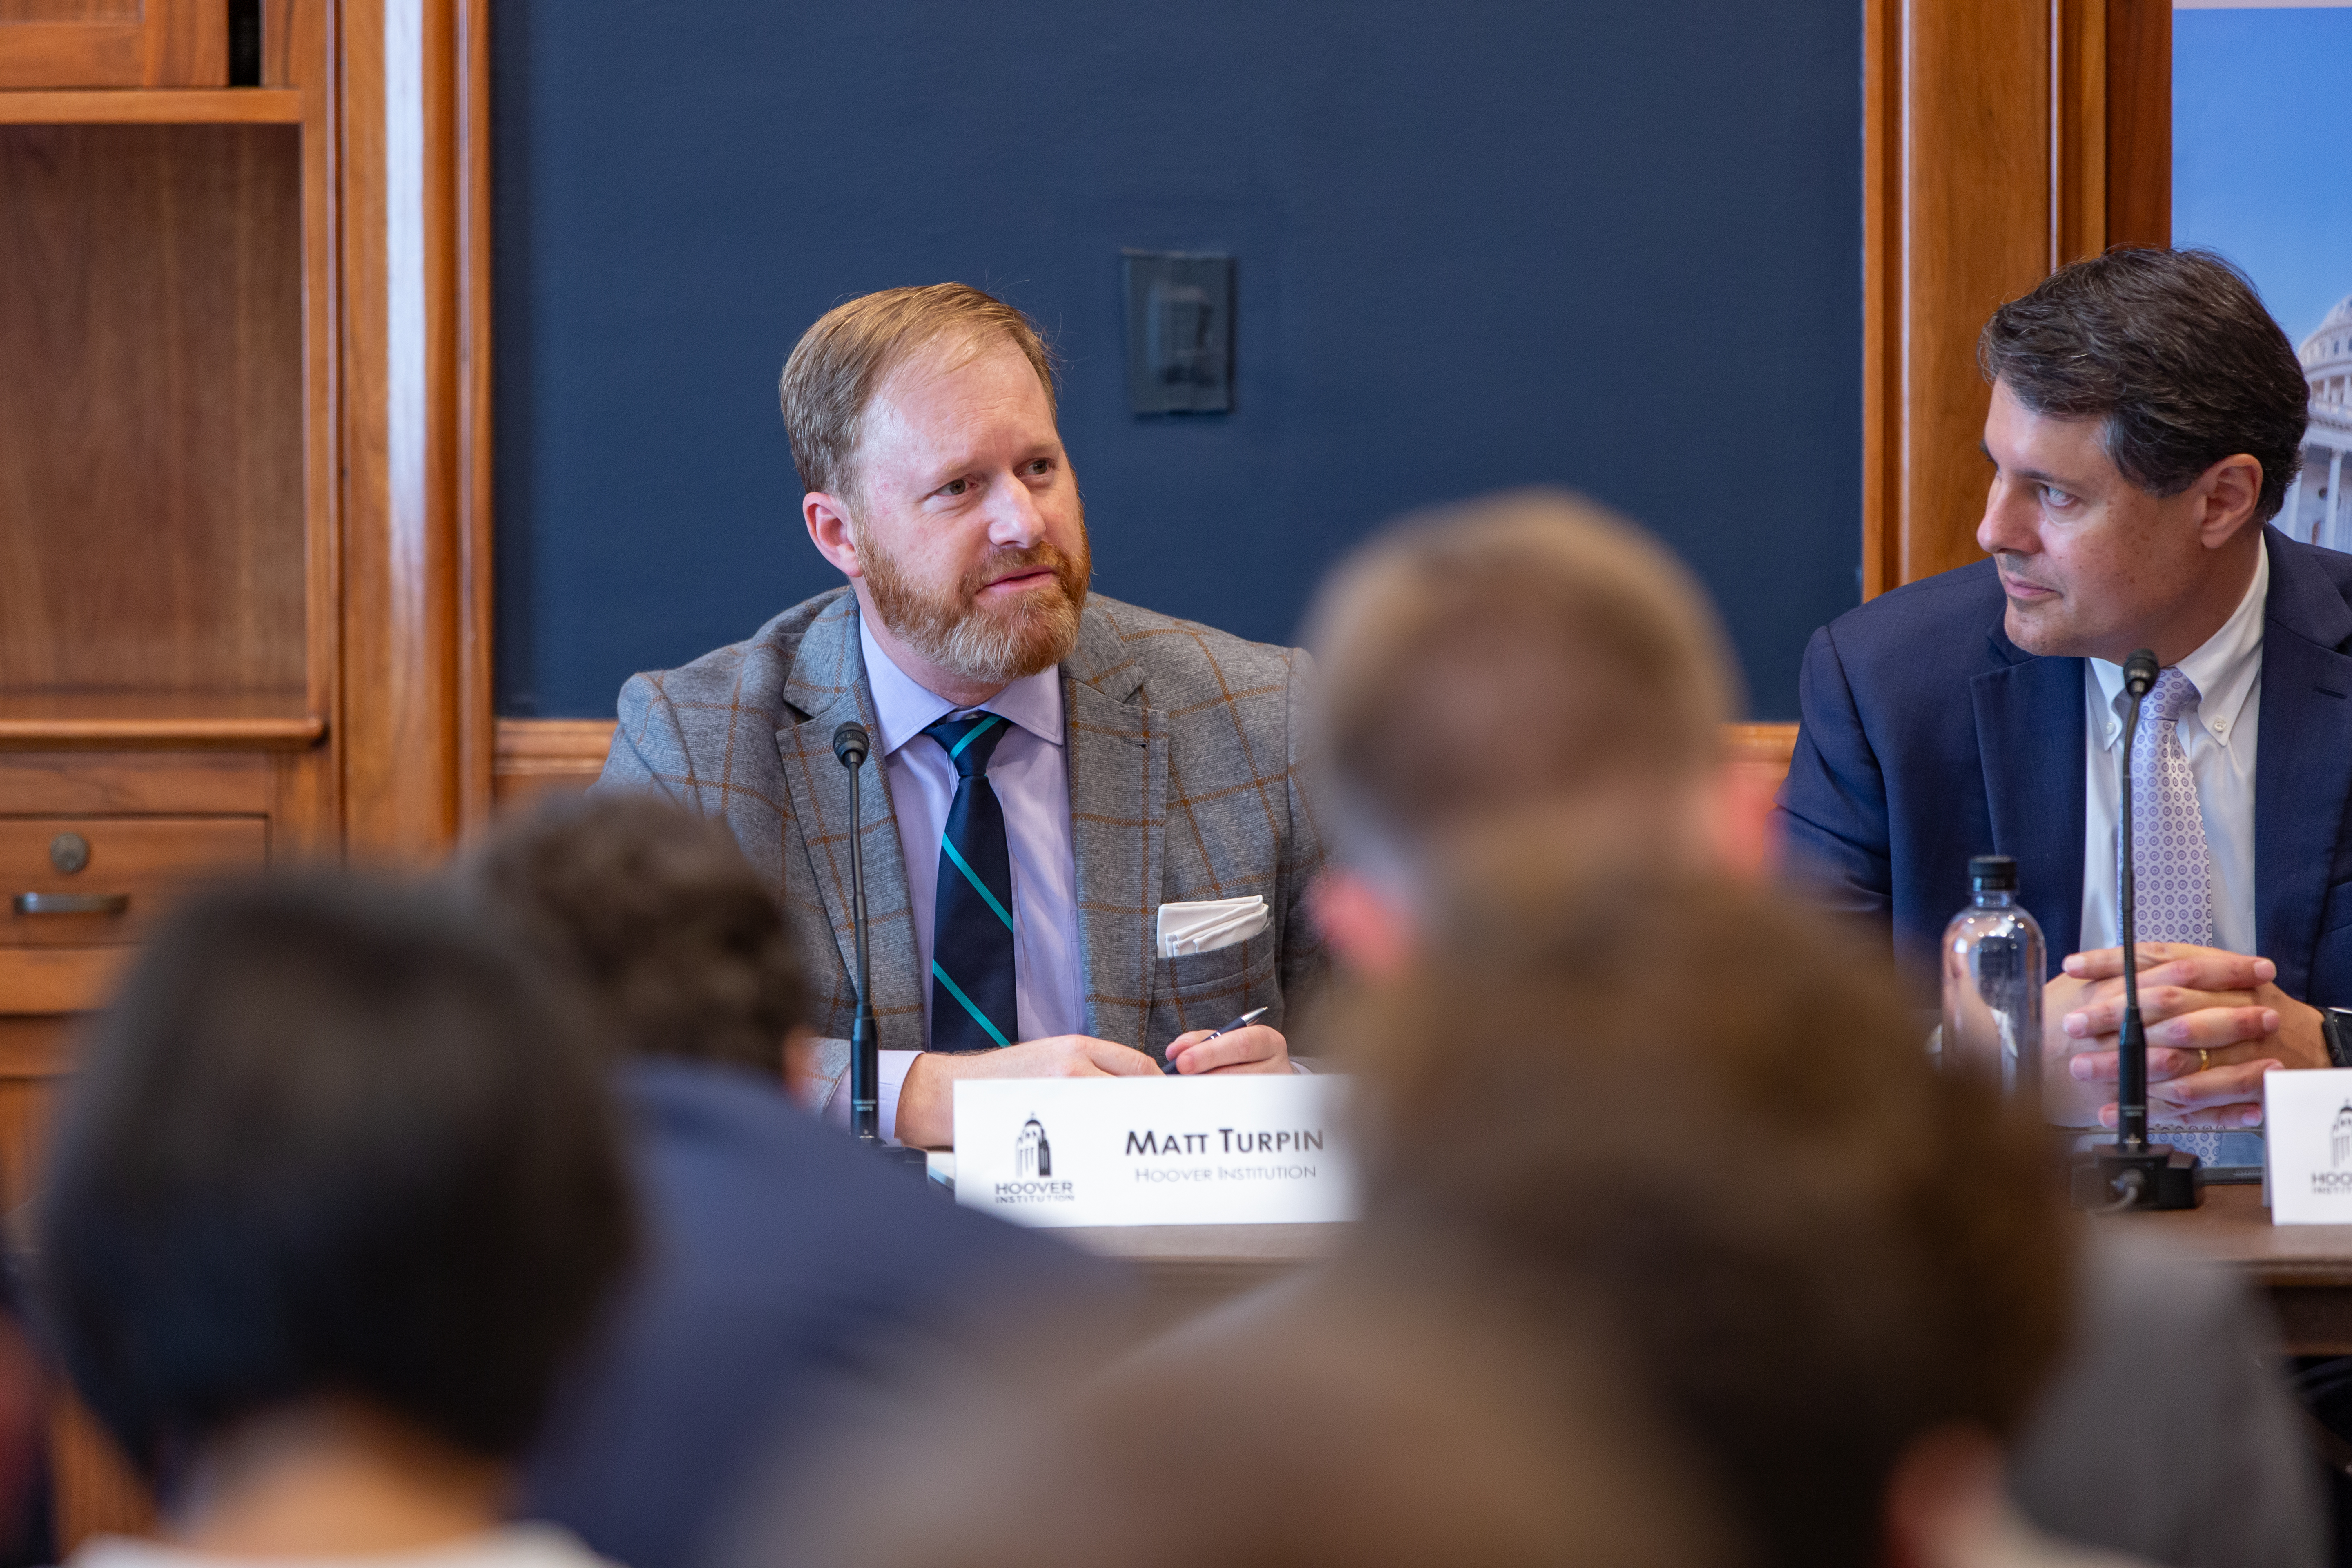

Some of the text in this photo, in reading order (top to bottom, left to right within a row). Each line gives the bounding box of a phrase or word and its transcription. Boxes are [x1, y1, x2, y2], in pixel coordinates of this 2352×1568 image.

[1125, 1128, 1323, 1156] MATT TURPIN
[1135, 1165, 1316, 1183] HOOVER INSTITUTION
[995, 1181, 1074, 1194] HOOVER
[995, 1195, 1075, 1203] INSTITUTION
